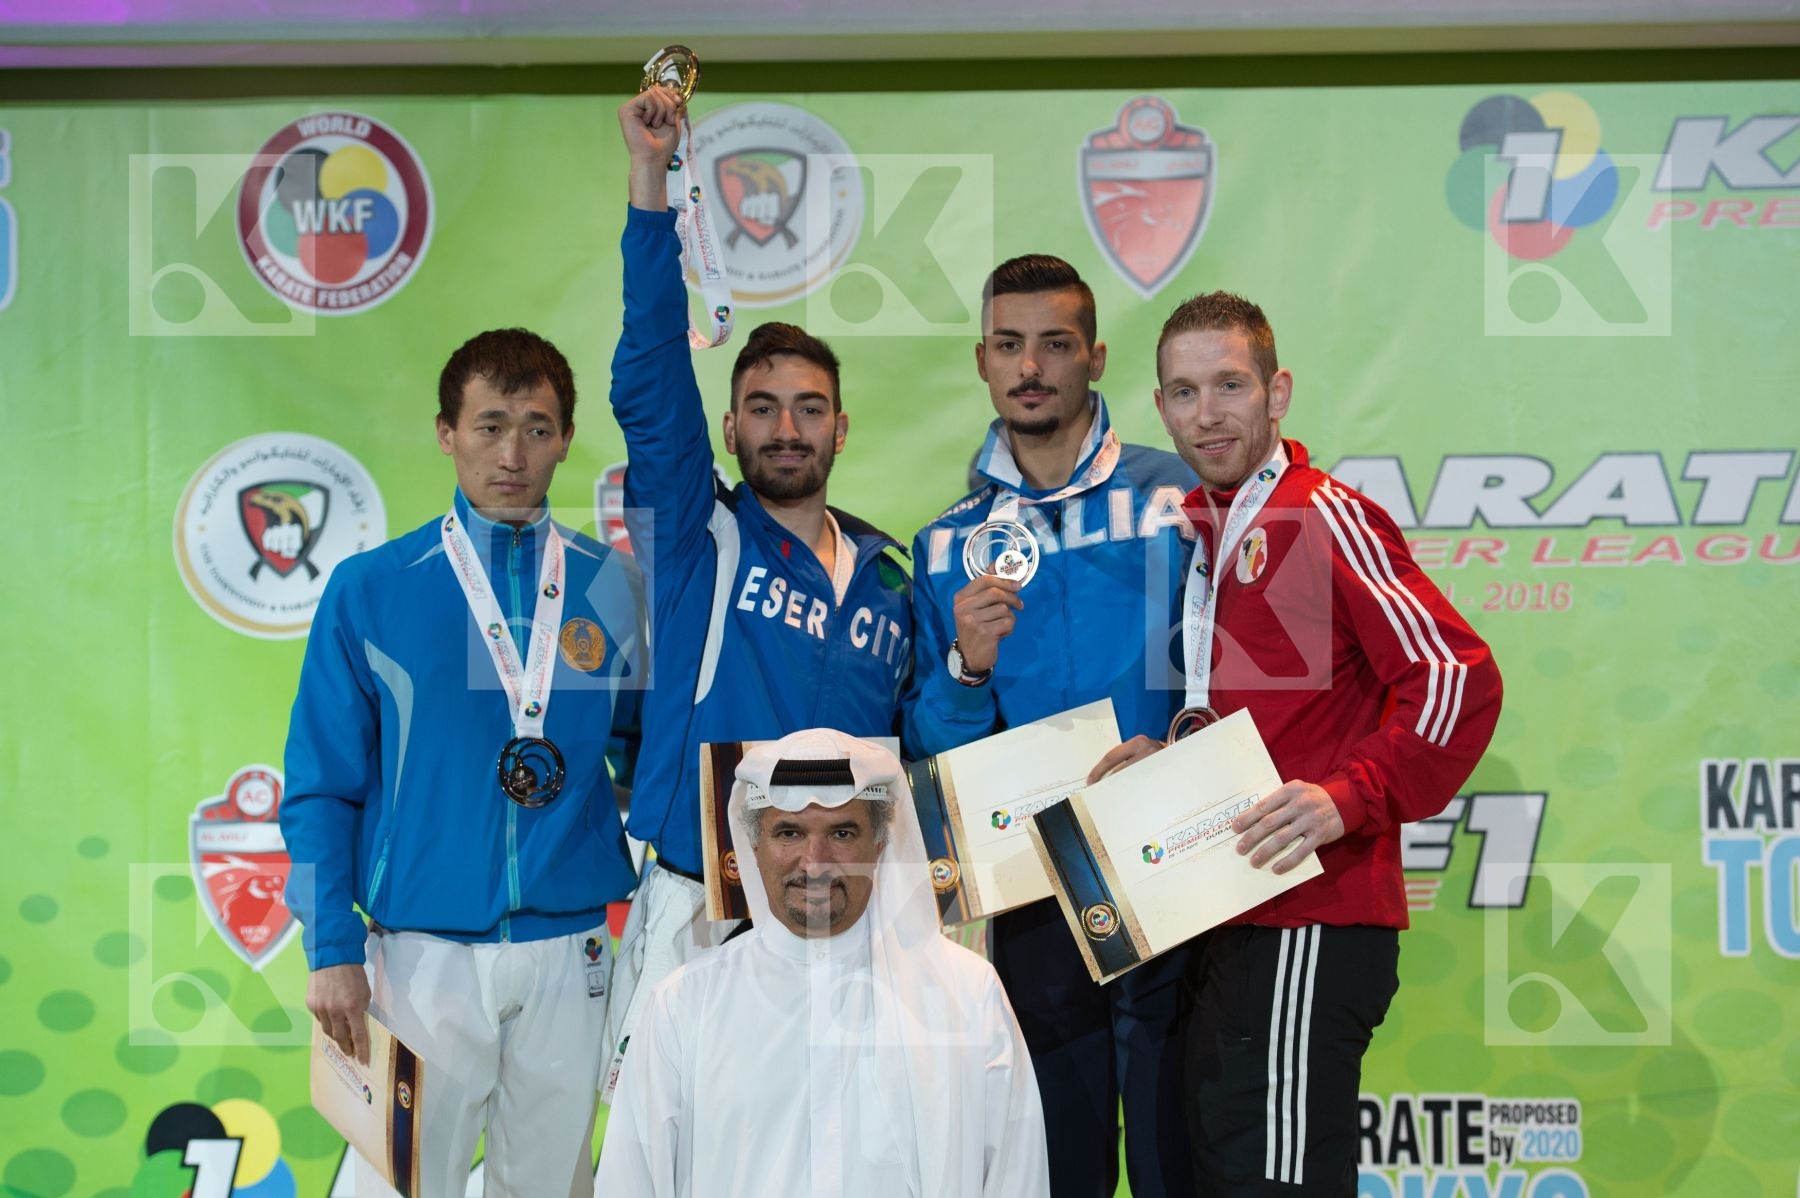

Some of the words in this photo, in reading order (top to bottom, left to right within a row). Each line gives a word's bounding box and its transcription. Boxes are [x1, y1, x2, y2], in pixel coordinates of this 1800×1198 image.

[297, 116, 371, 138] WORLD
[292, 198, 373, 234] WKF
[316, 252, 413, 308] FEDERATION
[1482, 582, 1574, 612] 2016
[1489, 1103, 1578, 1124] PROPOSED
[1490, 1132, 1514, 1163] by
[1522, 1129, 1579, 1158] 2020
